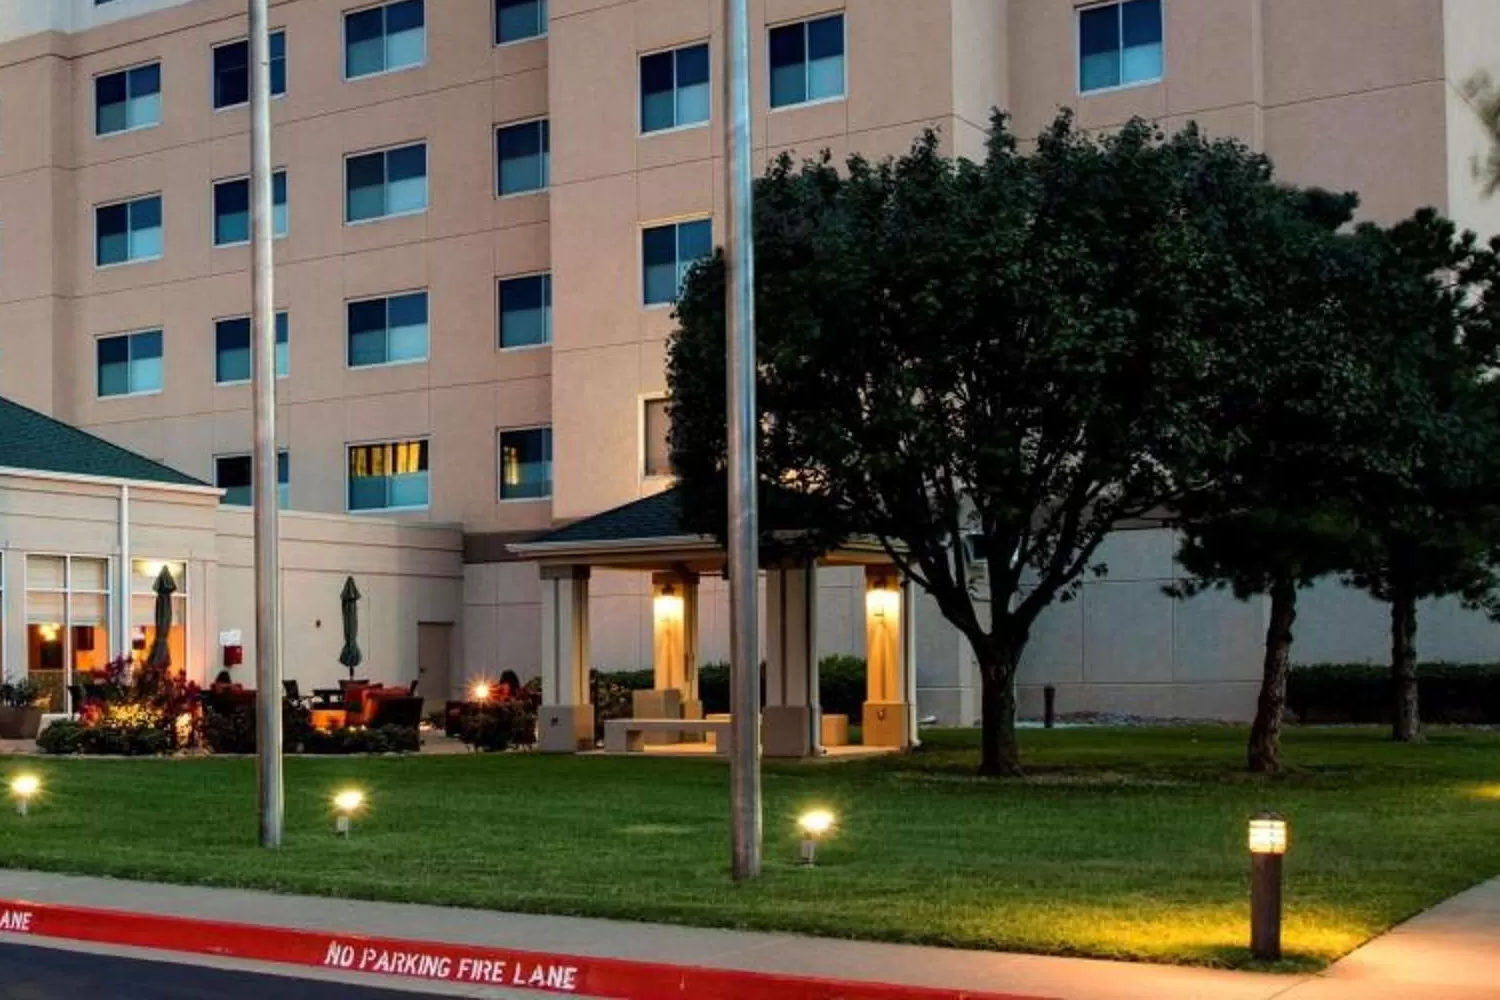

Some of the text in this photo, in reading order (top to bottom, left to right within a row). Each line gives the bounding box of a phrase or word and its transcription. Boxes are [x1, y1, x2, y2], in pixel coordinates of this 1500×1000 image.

[324, 940, 579, 990] NO PARKING FIRE LANE
